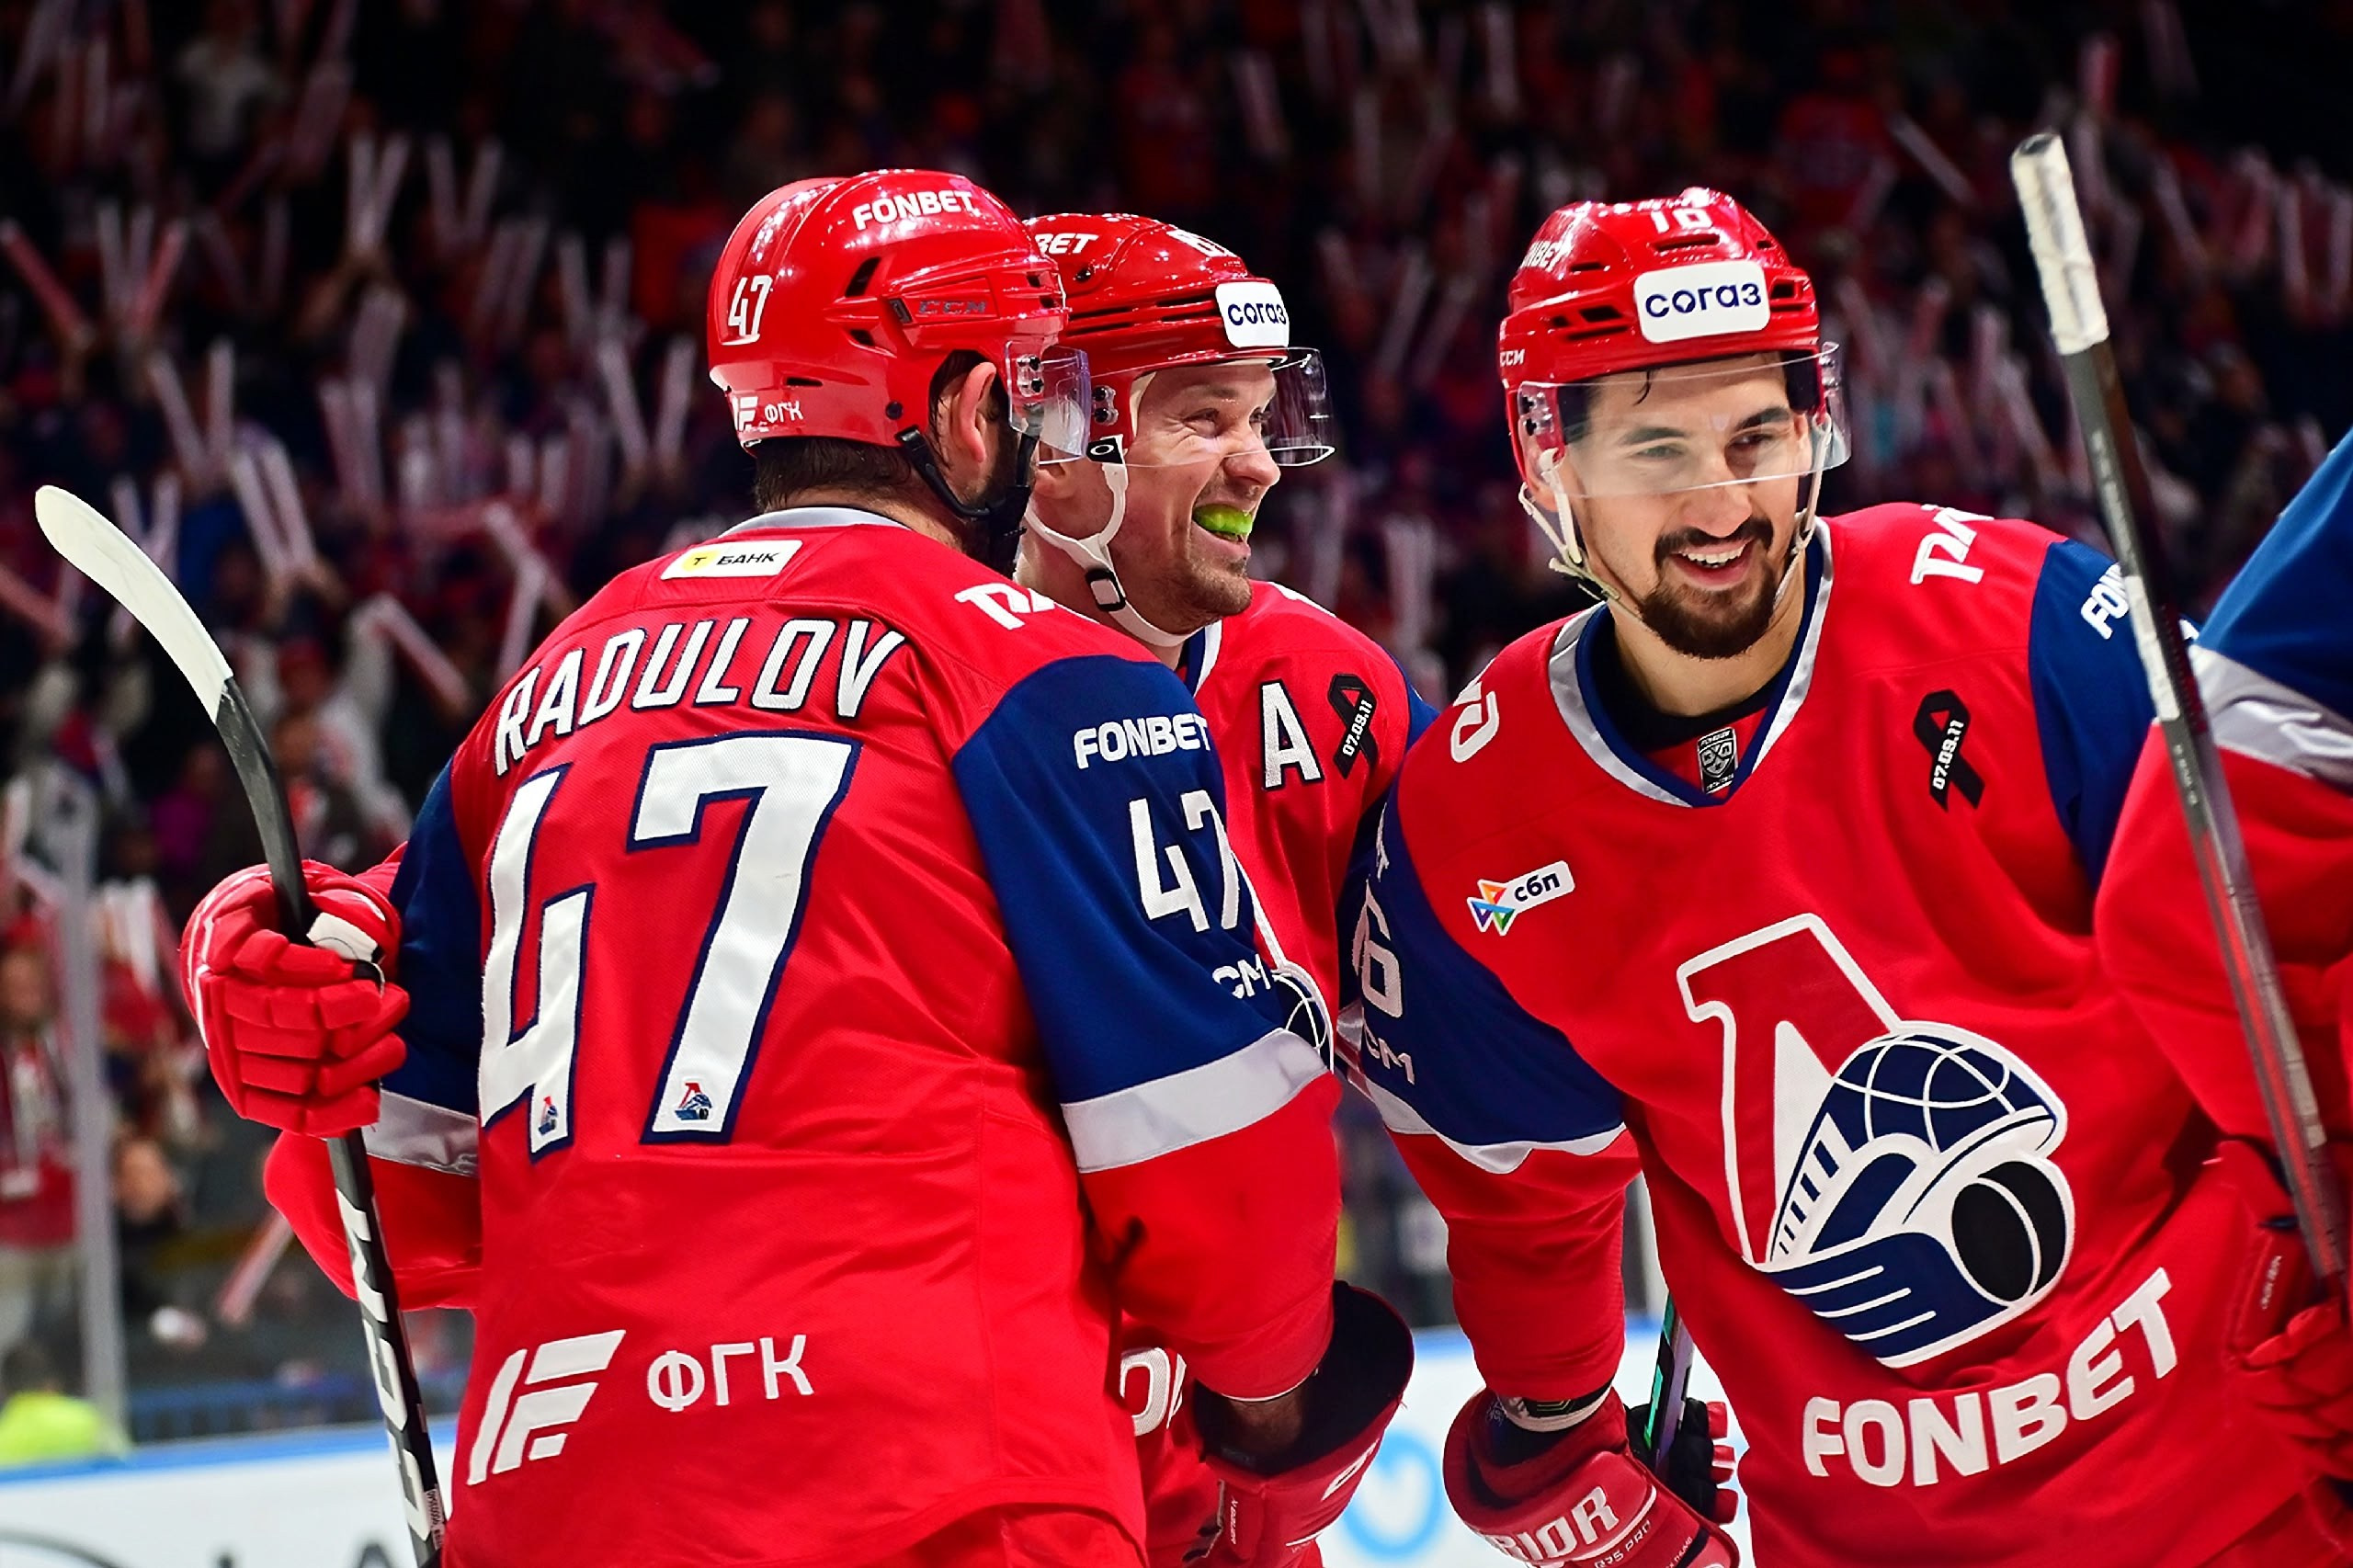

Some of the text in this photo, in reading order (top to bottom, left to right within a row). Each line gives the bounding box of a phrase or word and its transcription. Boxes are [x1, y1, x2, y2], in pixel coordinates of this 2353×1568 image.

[852, 189, 975, 231] FONBET
[1035, 232, 1098, 255] BET
[728, 275, 773, 337] 47
[919, 300, 985, 314] CCM
[1227, 302, 1286, 326] согаз
[1645, 281, 1762, 318] согаз
[1500, 348, 1526, 367] CCM
[765, 401, 803, 423] ФГК
[716, 552, 779, 565] БАНК
[493, 617, 906, 778] RADULOV
[1074, 713, 1211, 769] FONBET
[1261, 681, 1322, 790] A
[1343, 699, 1373, 758] 07.09.11
[1932, 719, 1965, 790] 07.09.11
[1130, 790, 1240, 932] 47
[1514, 871, 1561, 903] сбп
[477, 734, 864, 1165] 47
[647, 1334, 814, 1412] ФГК
[1802, 1266, 2178, 1488] FONBET
[1483, 1485, 1620, 1562] RIOR
